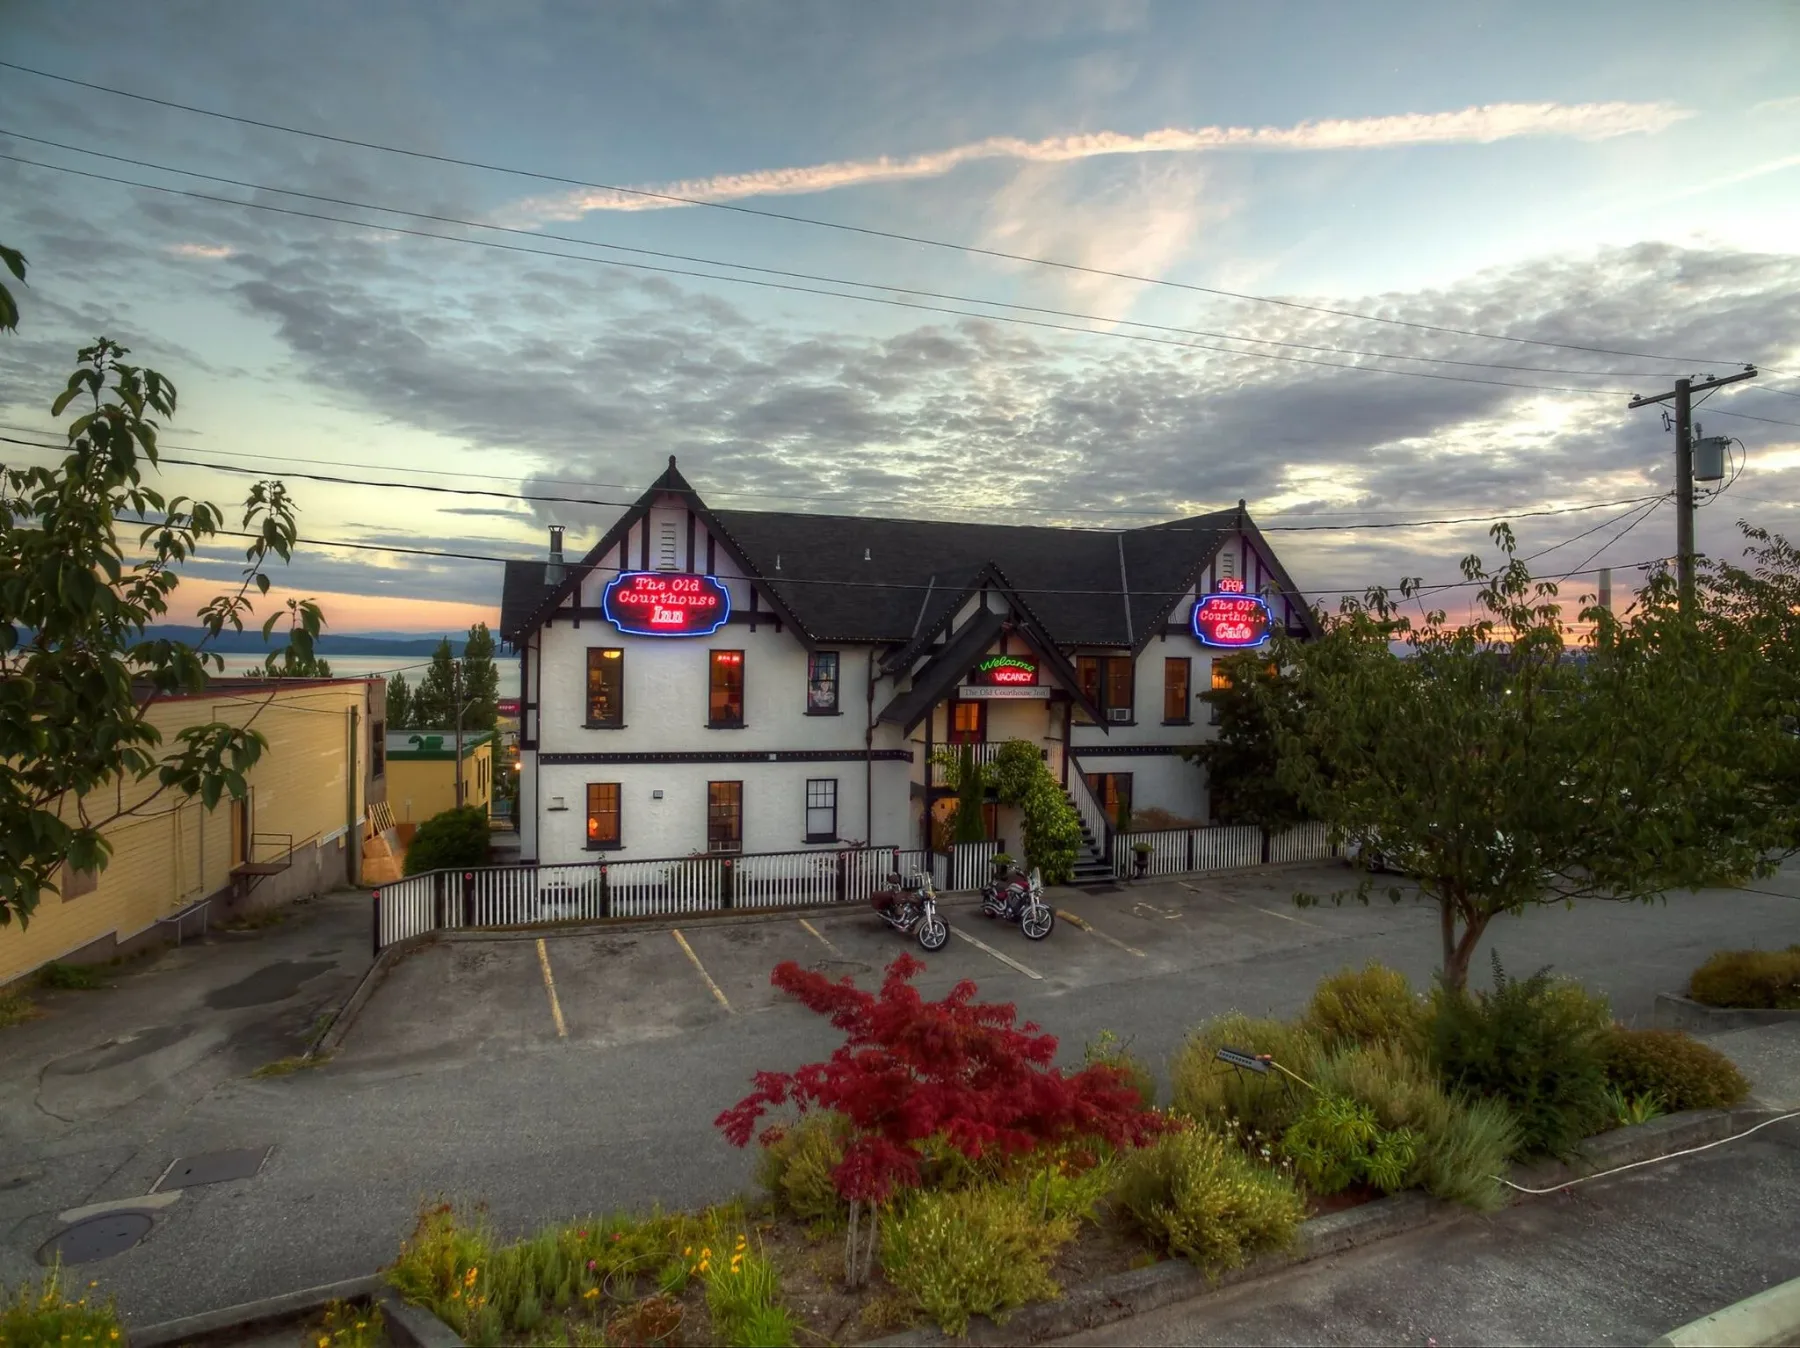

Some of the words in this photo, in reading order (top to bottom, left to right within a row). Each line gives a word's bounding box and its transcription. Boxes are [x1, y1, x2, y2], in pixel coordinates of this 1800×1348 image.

[635, 577, 666, 590] The
[672, 578, 700, 592] Old
[1221, 579, 1242, 592] OPEN
[618, 590, 716, 606] Courthouse
[1211, 599, 1234, 611] The
[651, 605, 684, 624] Inn
[1215, 622, 1252, 640] Cafe
[980, 656, 1035, 672] Welcome
[994, 672, 1033, 682] VACANCY
[964, 688, 977, 696] The
[980, 688, 993, 696] Old
[994, 688, 1031, 697] Courthouse
